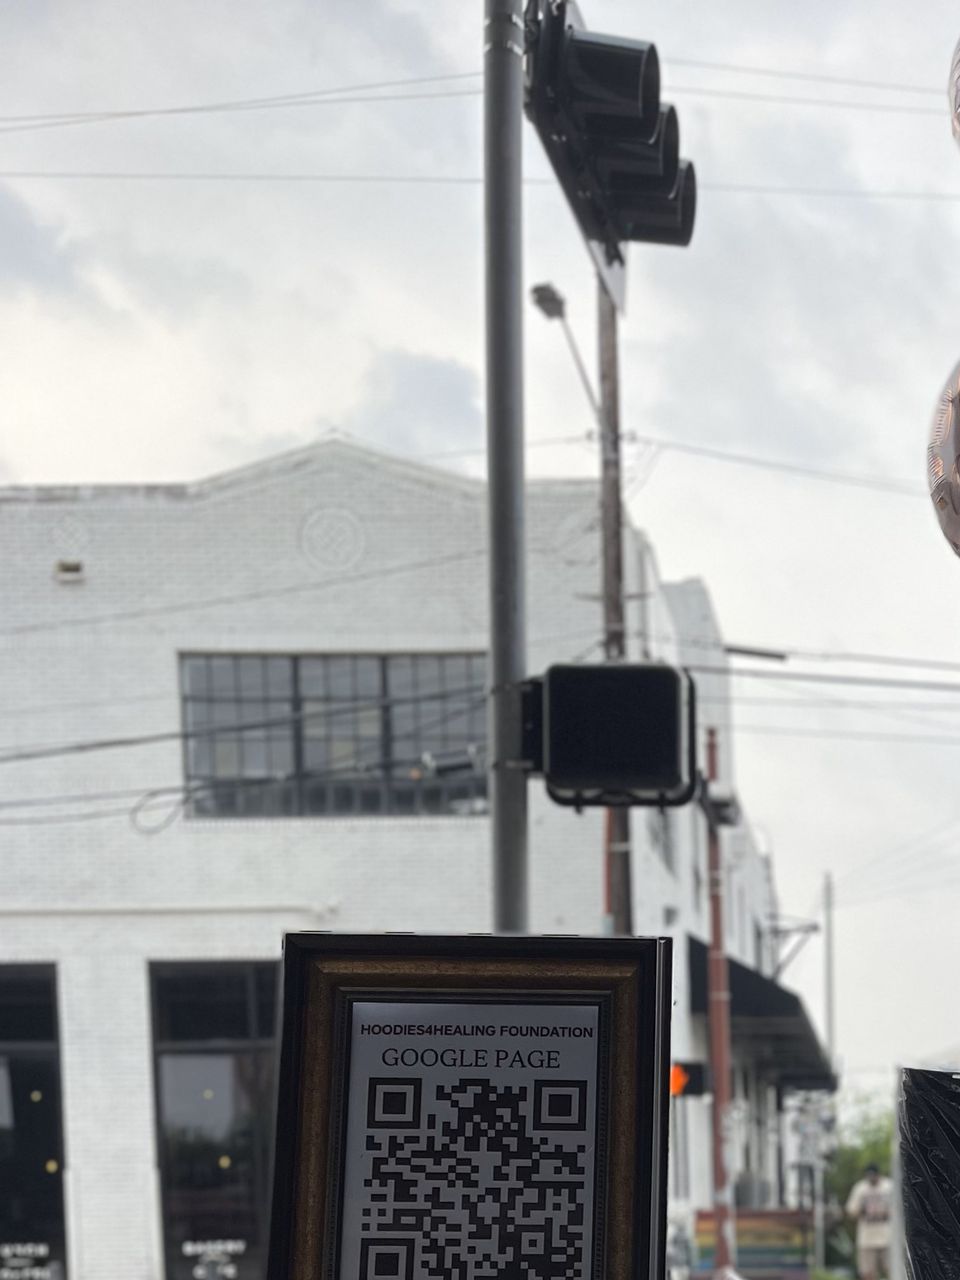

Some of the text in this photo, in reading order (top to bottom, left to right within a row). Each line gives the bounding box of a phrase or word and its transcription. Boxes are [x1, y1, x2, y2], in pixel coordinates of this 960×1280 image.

[360, 1023, 594, 1038] HOODIES4HEALING FOUNDATION
[381, 1048, 561, 1069] GOOGLE PAGE
